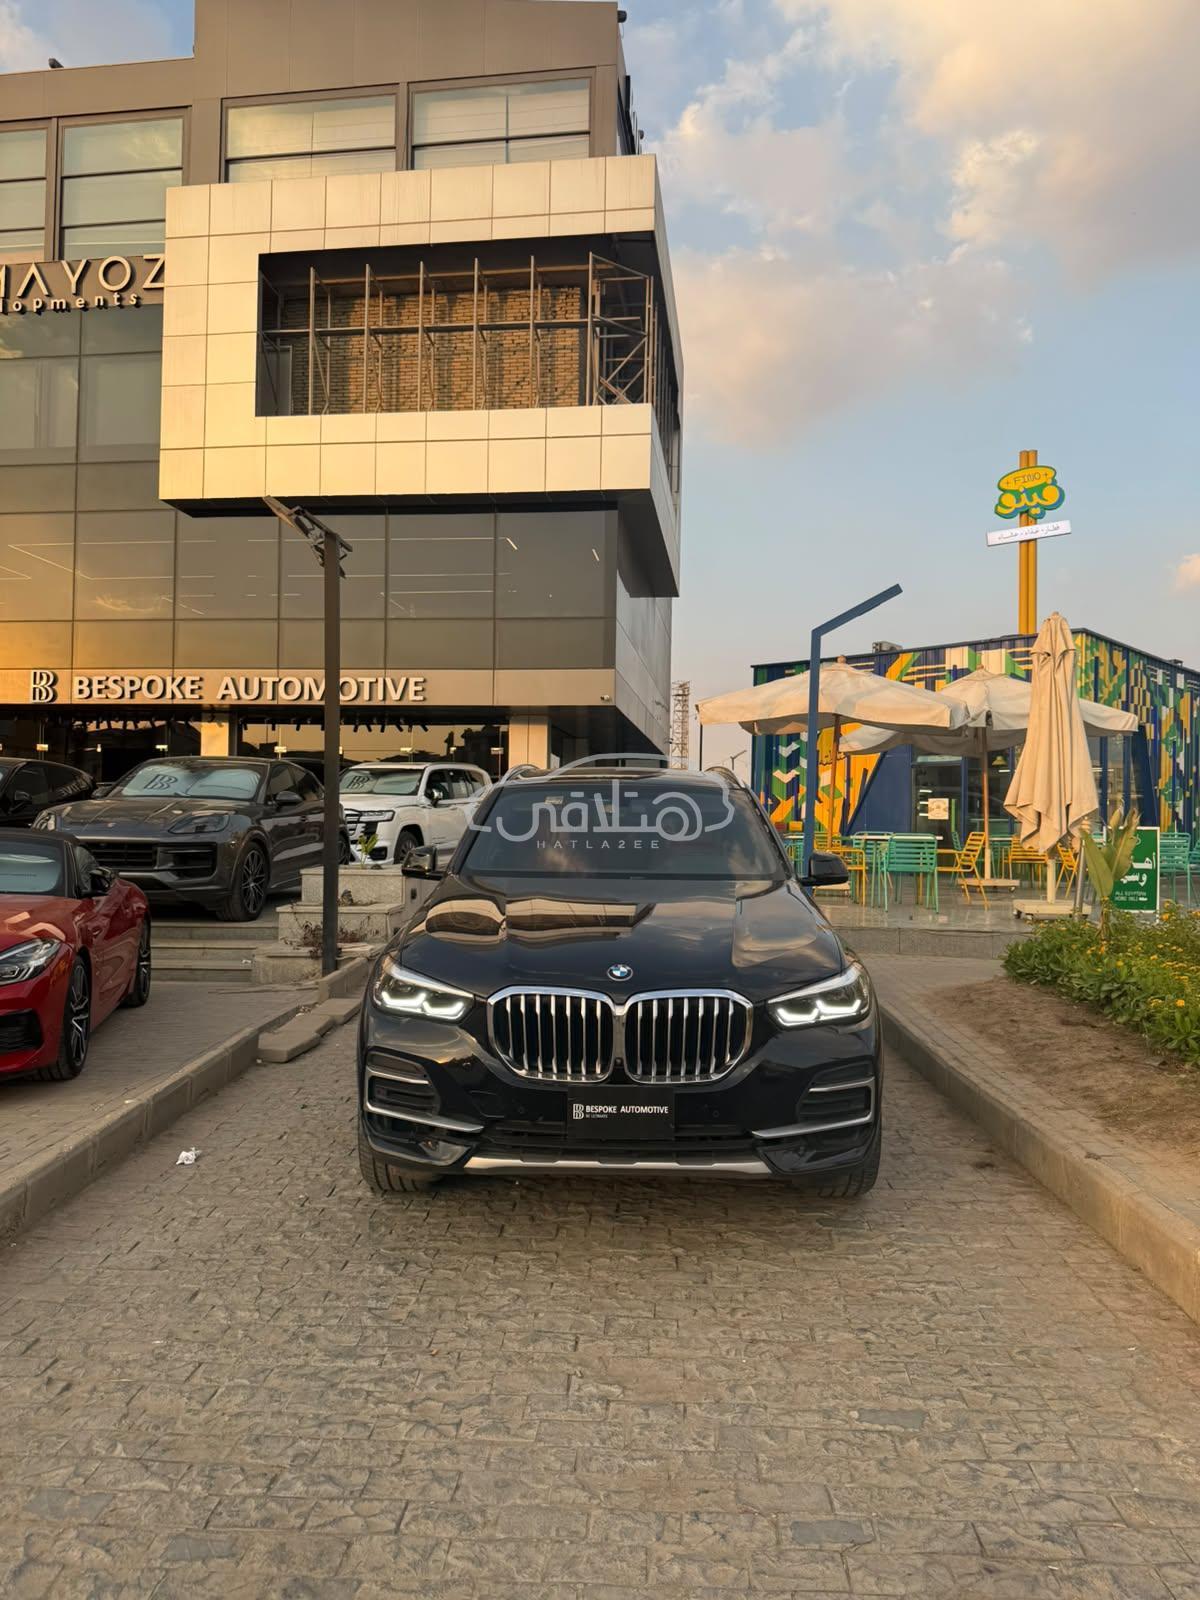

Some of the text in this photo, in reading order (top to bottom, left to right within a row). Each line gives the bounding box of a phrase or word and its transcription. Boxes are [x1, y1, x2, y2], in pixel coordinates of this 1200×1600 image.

[0, 254, 164, 298] AYOZ
[996, 479, 1061, 516] فينو
[73, 675, 201, 700] BESPOKE
[216, 675, 425, 701] AUTOMOTIVE
[585, 1105, 617, 1114] BESPOKE
[620, 1105, 669, 1114] AUTOMOTIVE
